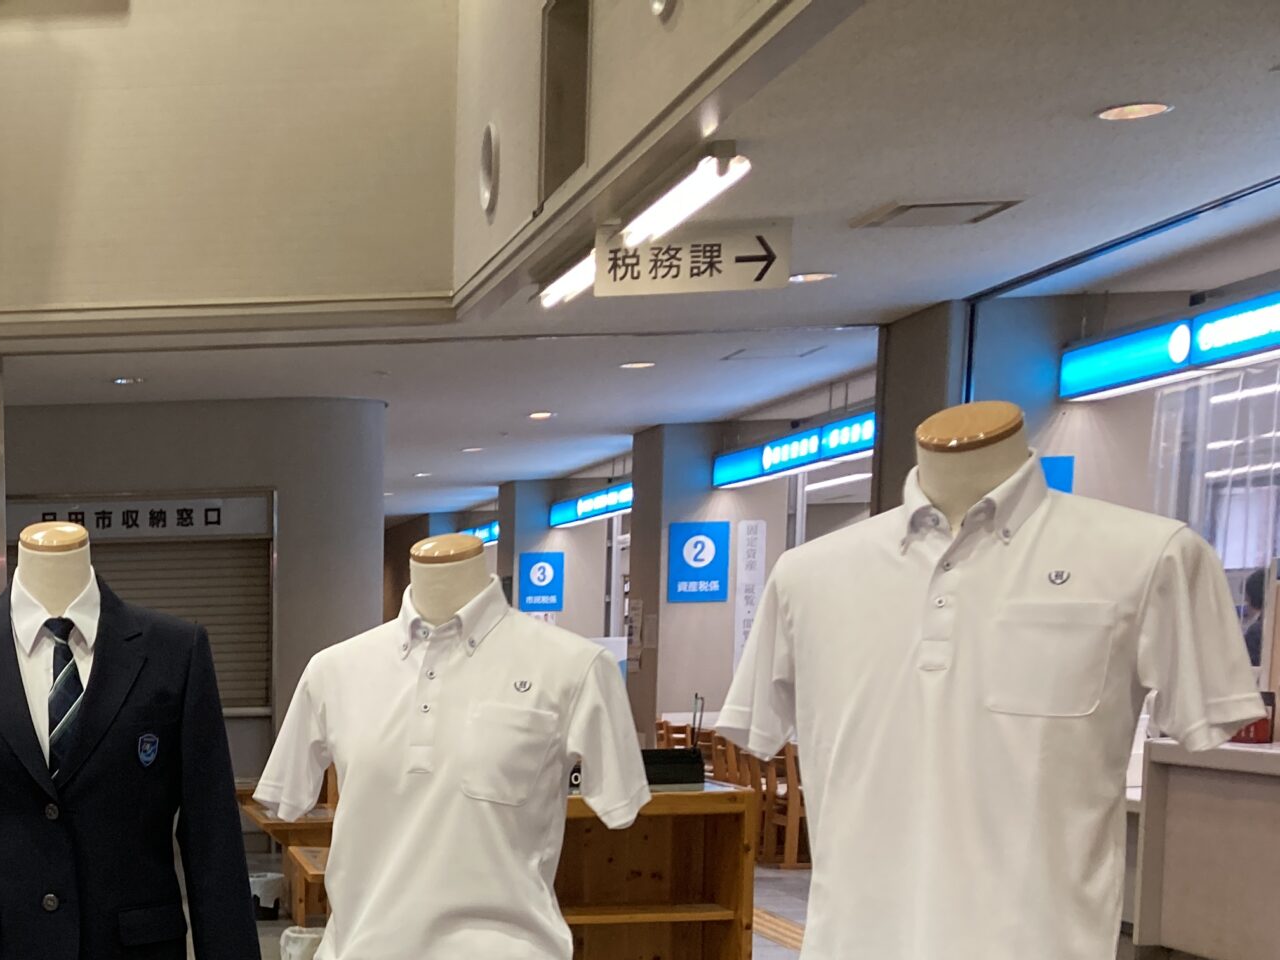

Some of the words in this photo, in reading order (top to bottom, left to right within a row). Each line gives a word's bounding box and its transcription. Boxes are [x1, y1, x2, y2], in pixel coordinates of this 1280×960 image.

[608, 243, 722, 281] 税務課
[692, 540, 706, 562] 2
[536, 565, 546, 583] 3
